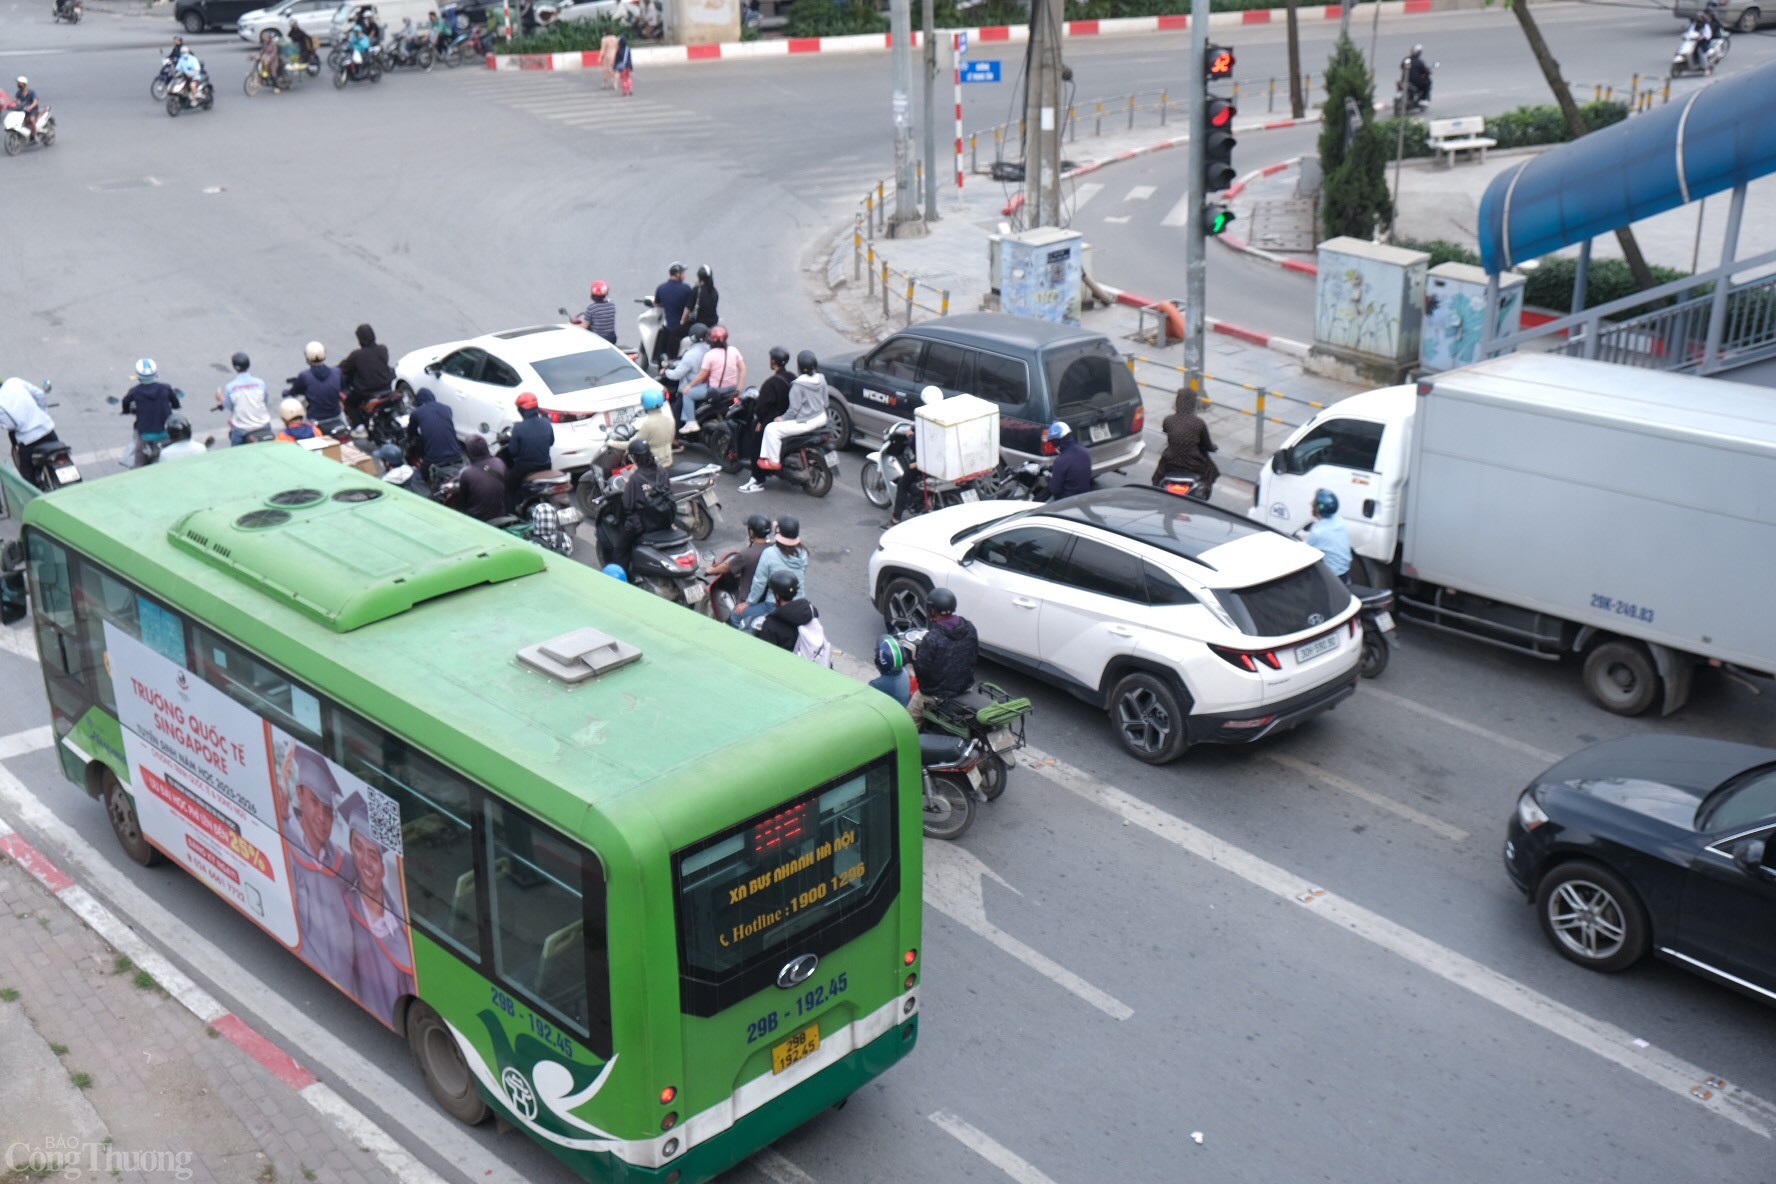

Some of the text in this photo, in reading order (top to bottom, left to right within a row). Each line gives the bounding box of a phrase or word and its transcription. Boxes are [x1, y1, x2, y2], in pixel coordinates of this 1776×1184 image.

[154, 712, 229, 776] SINGAPORE
[227, 828, 266, 873] 25%
[733, 909, 782, 942] Hotline
[790, 883, 827, 912] 1900
[749, 872, 772, 895] BUS
[491, 986, 515, 1018] 29B
[528, 1013, 573, 1058] 192.45
[747, 1012, 778, 1044] 29B
[796, 972, 848, 1016] 192.45
[780, 1040, 815, 1070] 192.45
